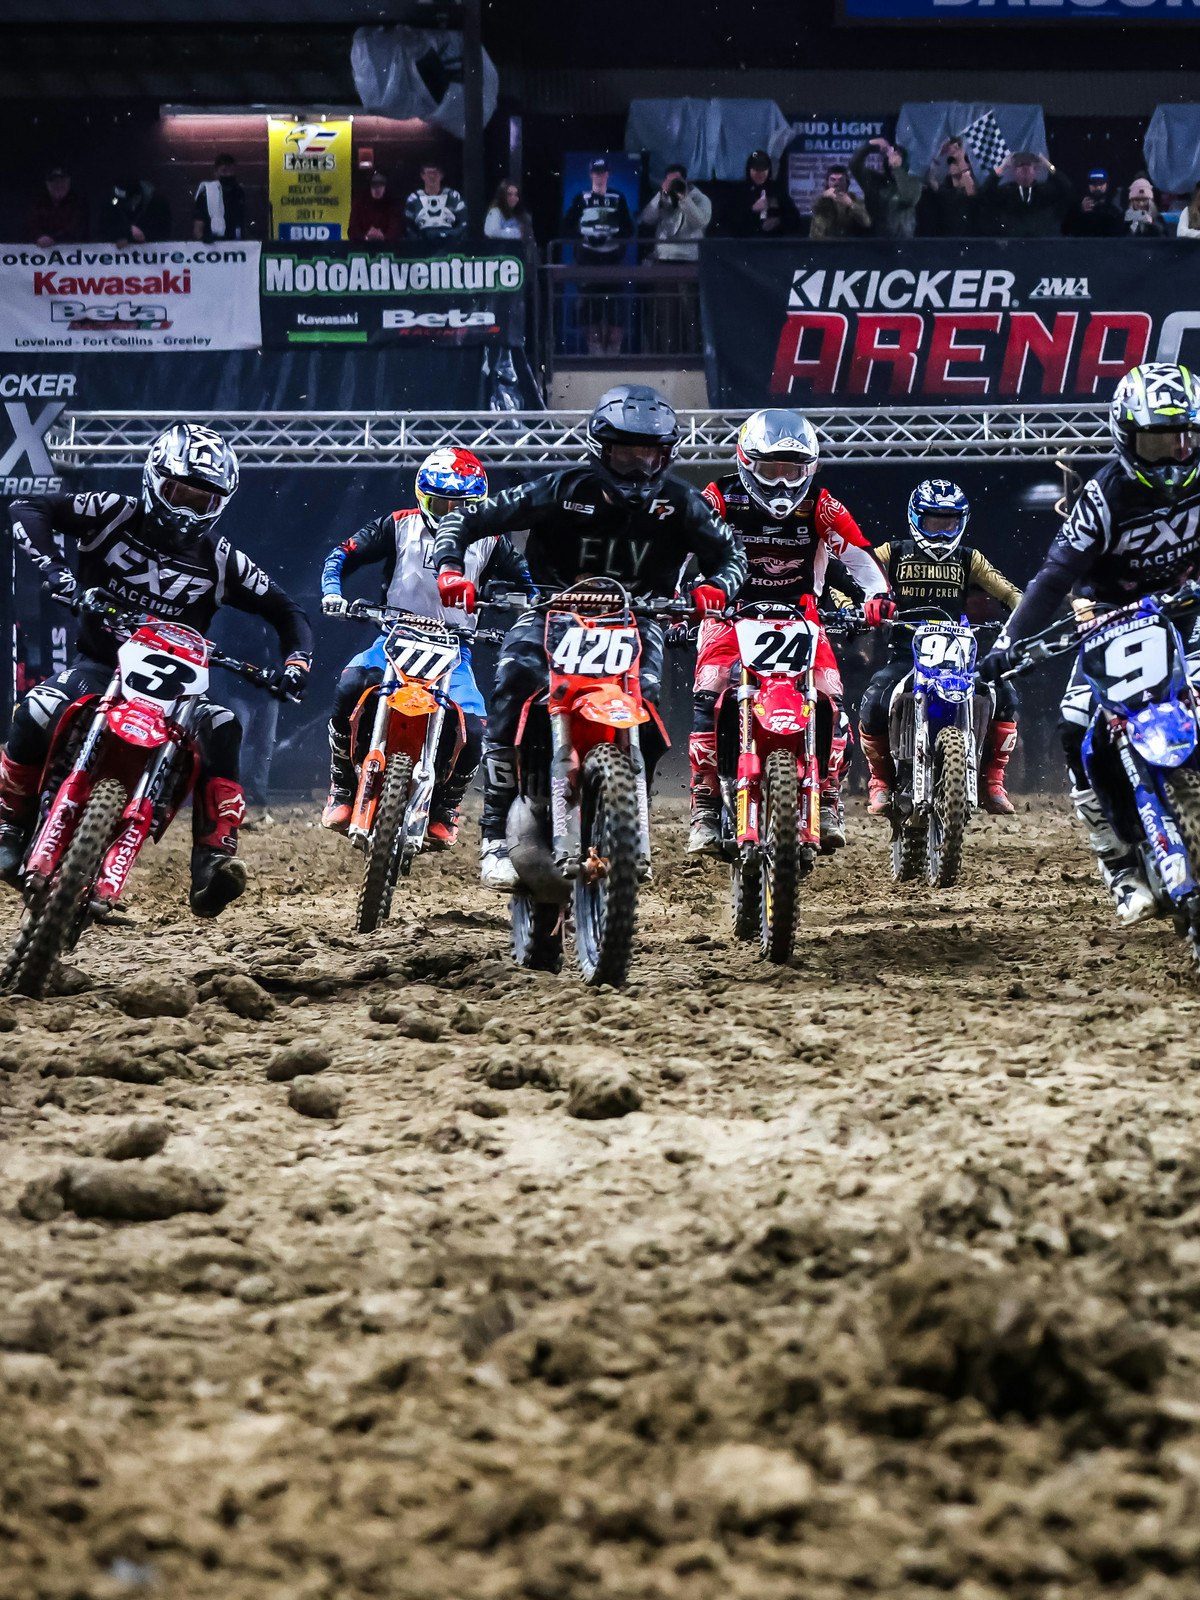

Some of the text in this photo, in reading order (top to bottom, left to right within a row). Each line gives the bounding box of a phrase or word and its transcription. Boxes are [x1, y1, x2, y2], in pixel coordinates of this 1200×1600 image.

[832, 122, 884, 136] LIGHT
[284, 154, 336, 170] EAGLES
[296, 210, 324, 220] 2017
[290, 226, 330, 240] BUD
[33, 268, 191, 296] Kawasaki
[265, 257, 520, 292] MotoAdventure
[828, 269, 1016, 308] KICKER
[50, 301, 168, 323] Beta
[297, 312, 359, 325] Kawasaki
[382, 310, 496, 329] Beta
[15, 335, 212, 348] Loveland Fort Collins Greeley
[563, 500, 596, 515] WPS
[579, 537, 651, 577] FLY
[103, 541, 215, 605] FXR
[900, 564, 962, 581] FASTHOUSE
[551, 592, 623, 603] RENTHAL
[901, 585, 925, 597] MOTO
[936, 588, 959, 598] CREW
[923, 626, 943, 634] COLE
[1084, 614, 1160, 653] MARQUIER
[394, 638, 460, 680] 777
[552, 627, 636, 674] 426
[749, 630, 814, 672] 24
[918, 634, 972, 669] 94
[1104, 625, 1168, 703] 9
[125, 653, 198, 701] 3
[770, 722, 801, 731] RED
[103, 824, 142, 893] Hoosier
[1160, 852, 1186, 894] 9
